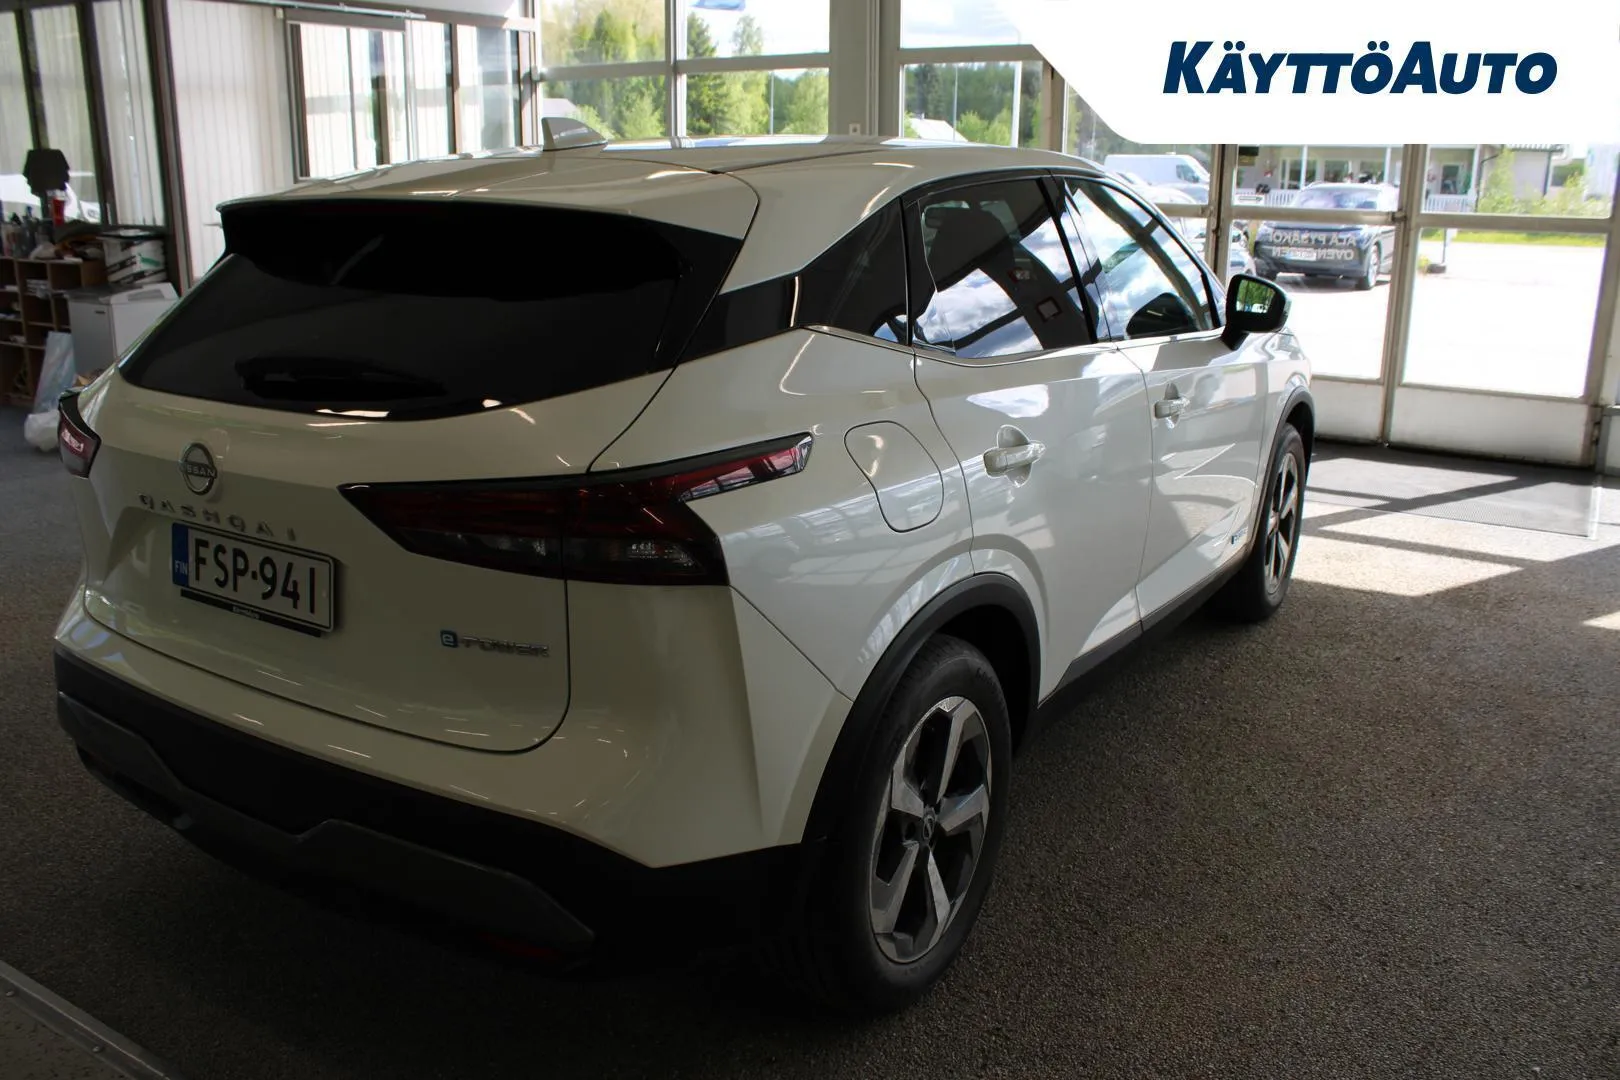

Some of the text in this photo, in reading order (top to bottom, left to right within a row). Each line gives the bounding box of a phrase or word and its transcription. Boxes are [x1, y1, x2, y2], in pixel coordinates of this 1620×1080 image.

[181, 462, 216, 477] SSAN
[139, 494, 296, 541] QASHQAI
[174, 559, 188, 575] FIN
[194, 538, 316, 615] FSP-941
